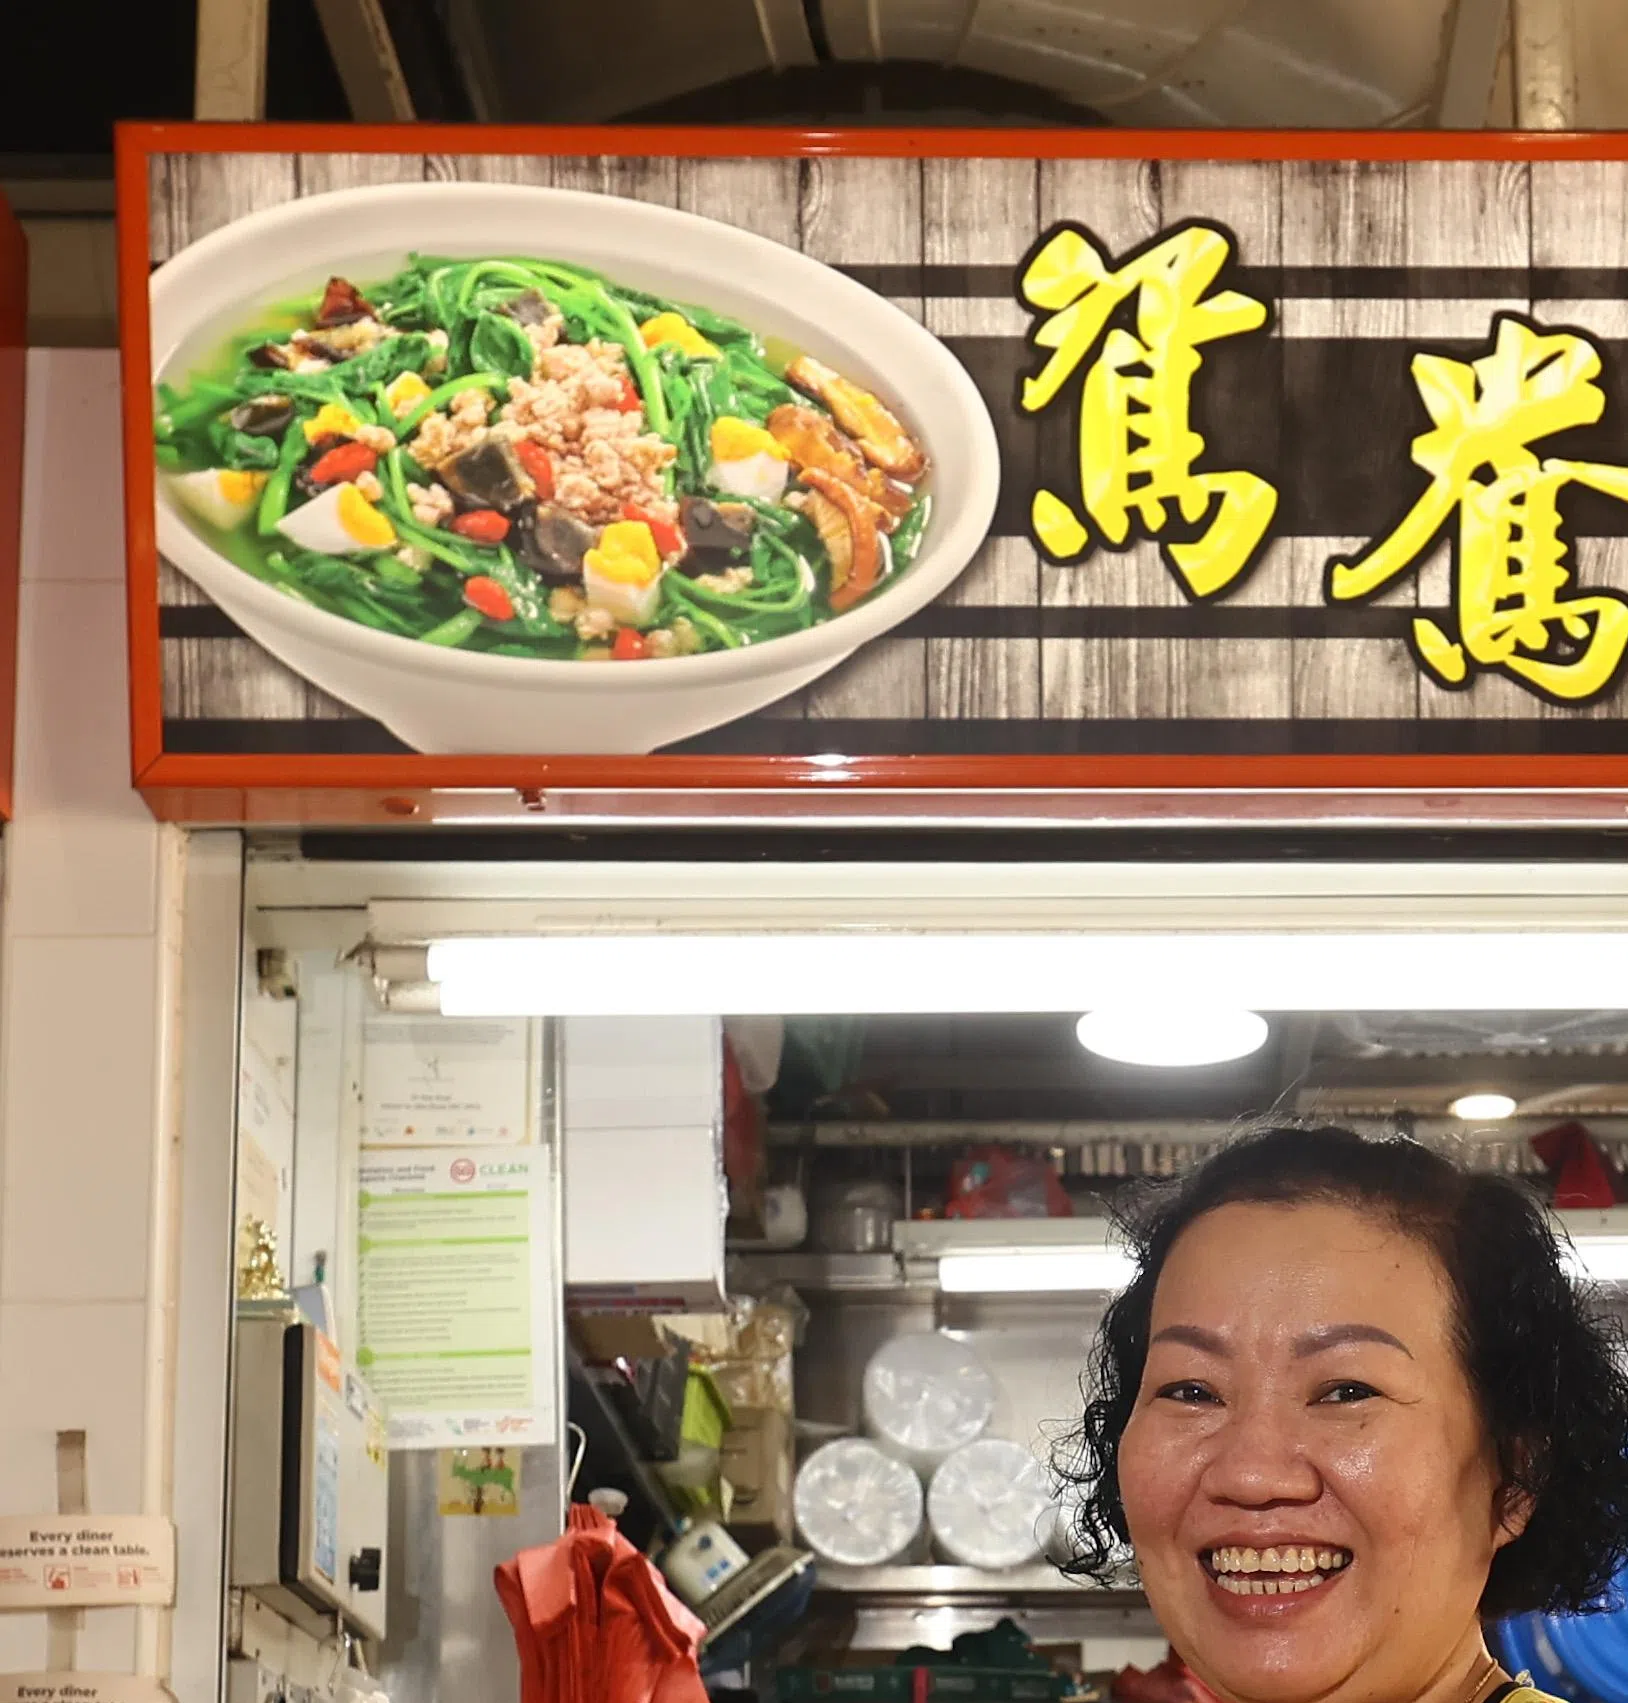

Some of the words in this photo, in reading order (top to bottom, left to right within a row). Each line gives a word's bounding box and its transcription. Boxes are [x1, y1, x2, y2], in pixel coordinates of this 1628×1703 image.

[479, 1163, 528, 1176] CLEAN
[29, 1530, 73, 1543] Every
[76, 1529, 114, 1541] diner
[0, 1547, 55, 1557] eserves
[72, 1544, 110, 1556] clean
[113, 1544, 149, 1556] table.
[17, 1685, 55, 1698] Every
[59, 1684, 98, 1697] diner
